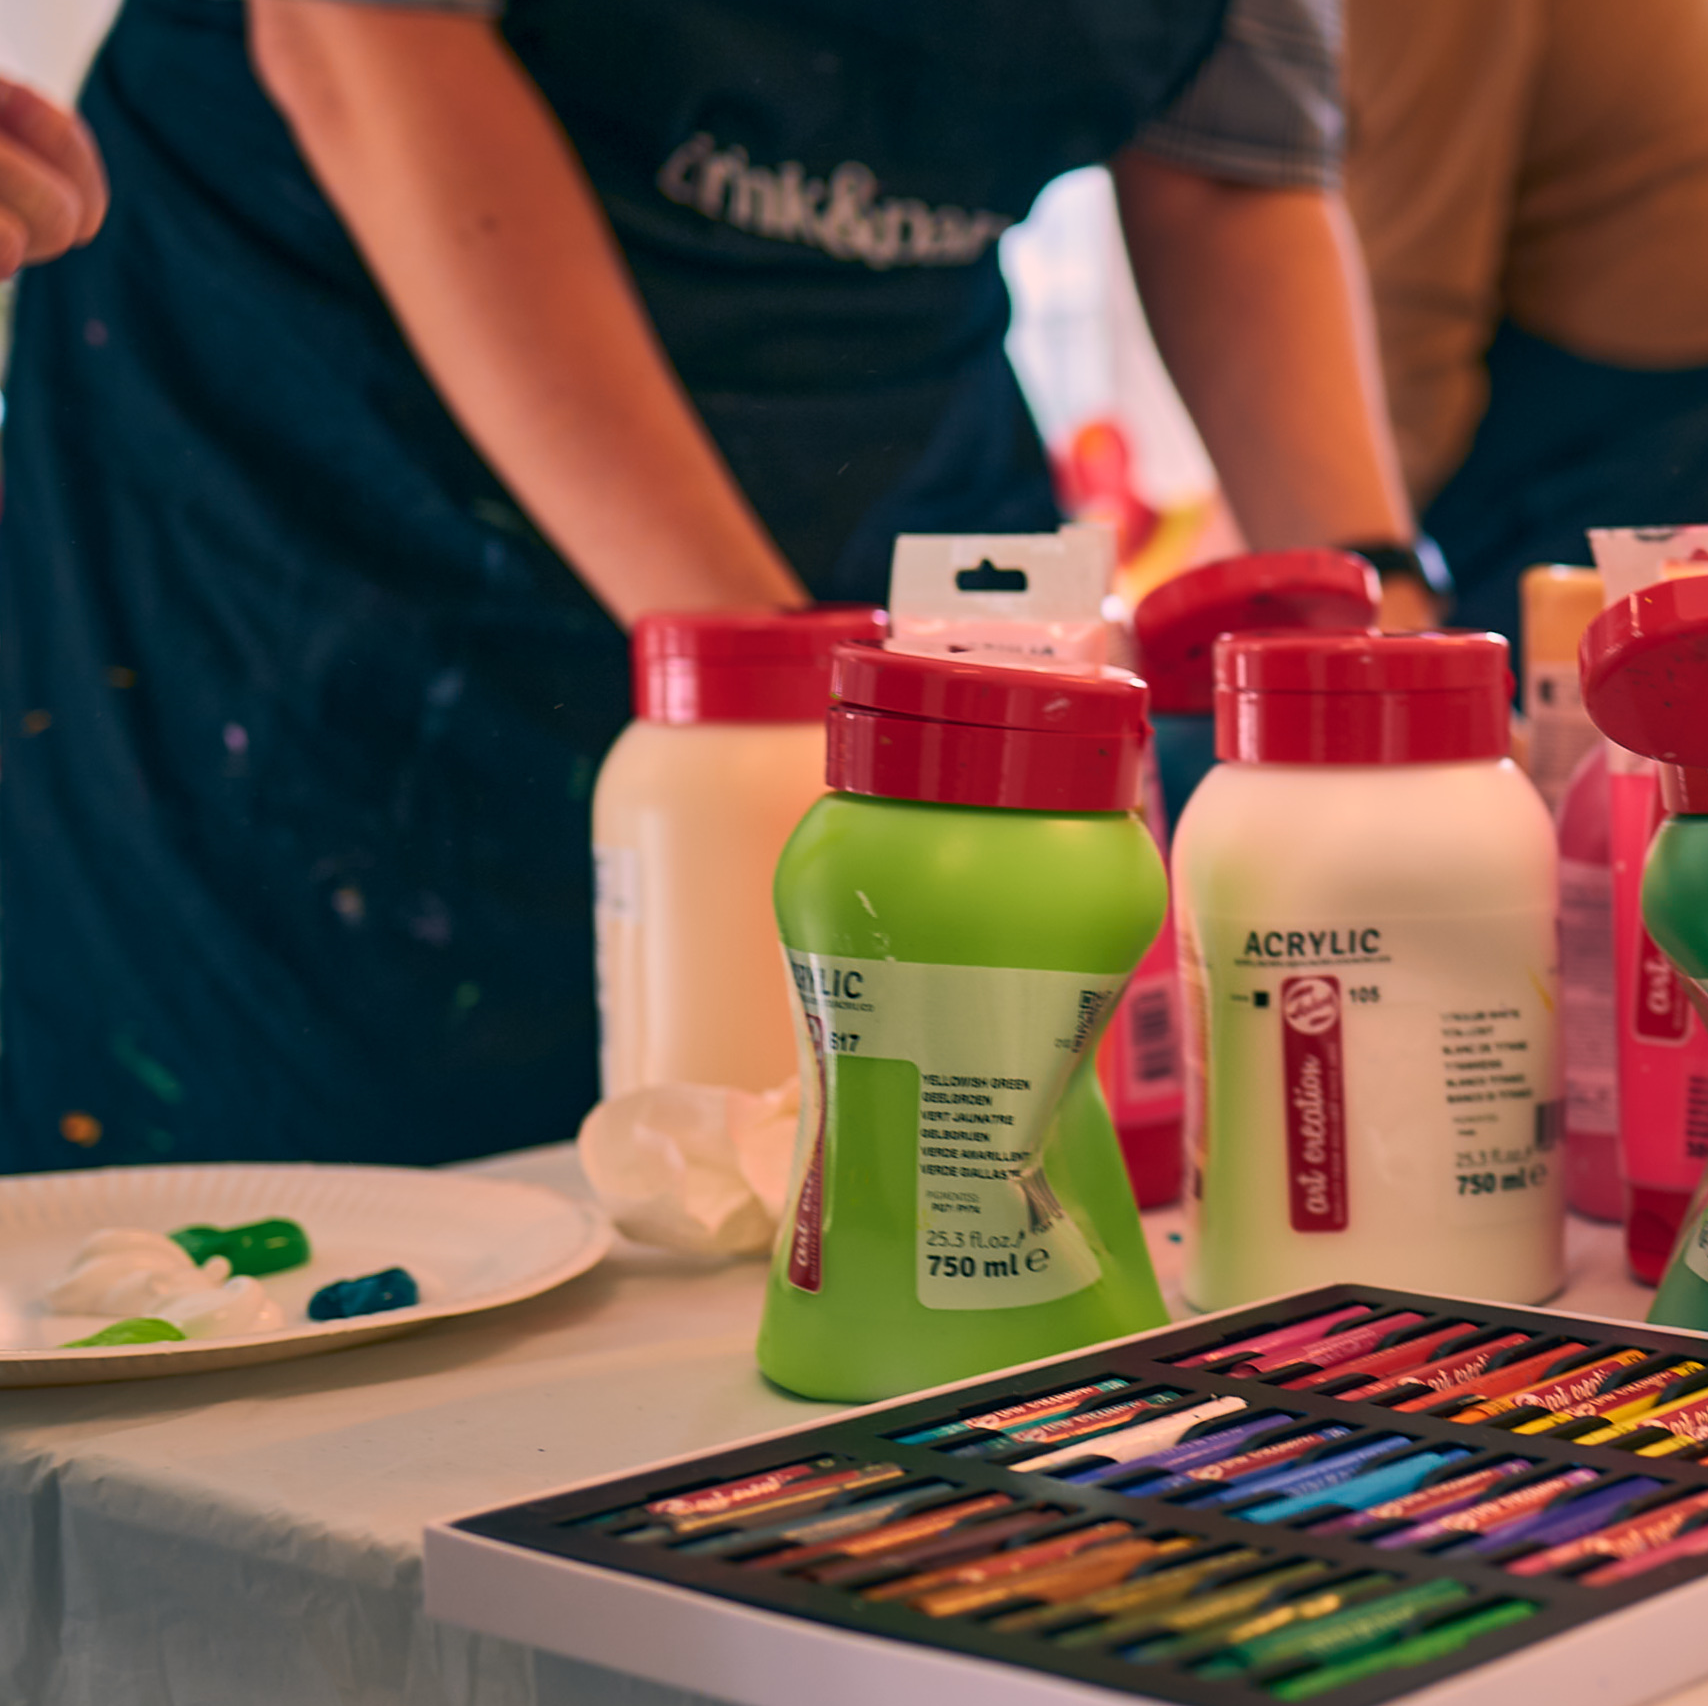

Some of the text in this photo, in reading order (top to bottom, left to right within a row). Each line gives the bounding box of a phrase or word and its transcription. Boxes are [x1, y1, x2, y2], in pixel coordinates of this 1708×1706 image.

[1244, 927, 1381, 957] ACRYLIC
[1348, 985, 1381, 1004] 105
[921, 1073, 1032, 1091] YELLOWISH GREEN
[921, 1110, 951, 1122] VERT
[1292, 1053, 1328, 1164] creation
[920, 1146, 959, 1159] VERDE
[920, 1164, 959, 1178] VERDE
[1297, 1169, 1330, 1214] art
[1455, 1172, 1497, 1196] 750
[926, 1228, 966, 1248] 25.3
[926, 1254, 977, 1278] 750
[983, 1252, 1020, 1278] ml
